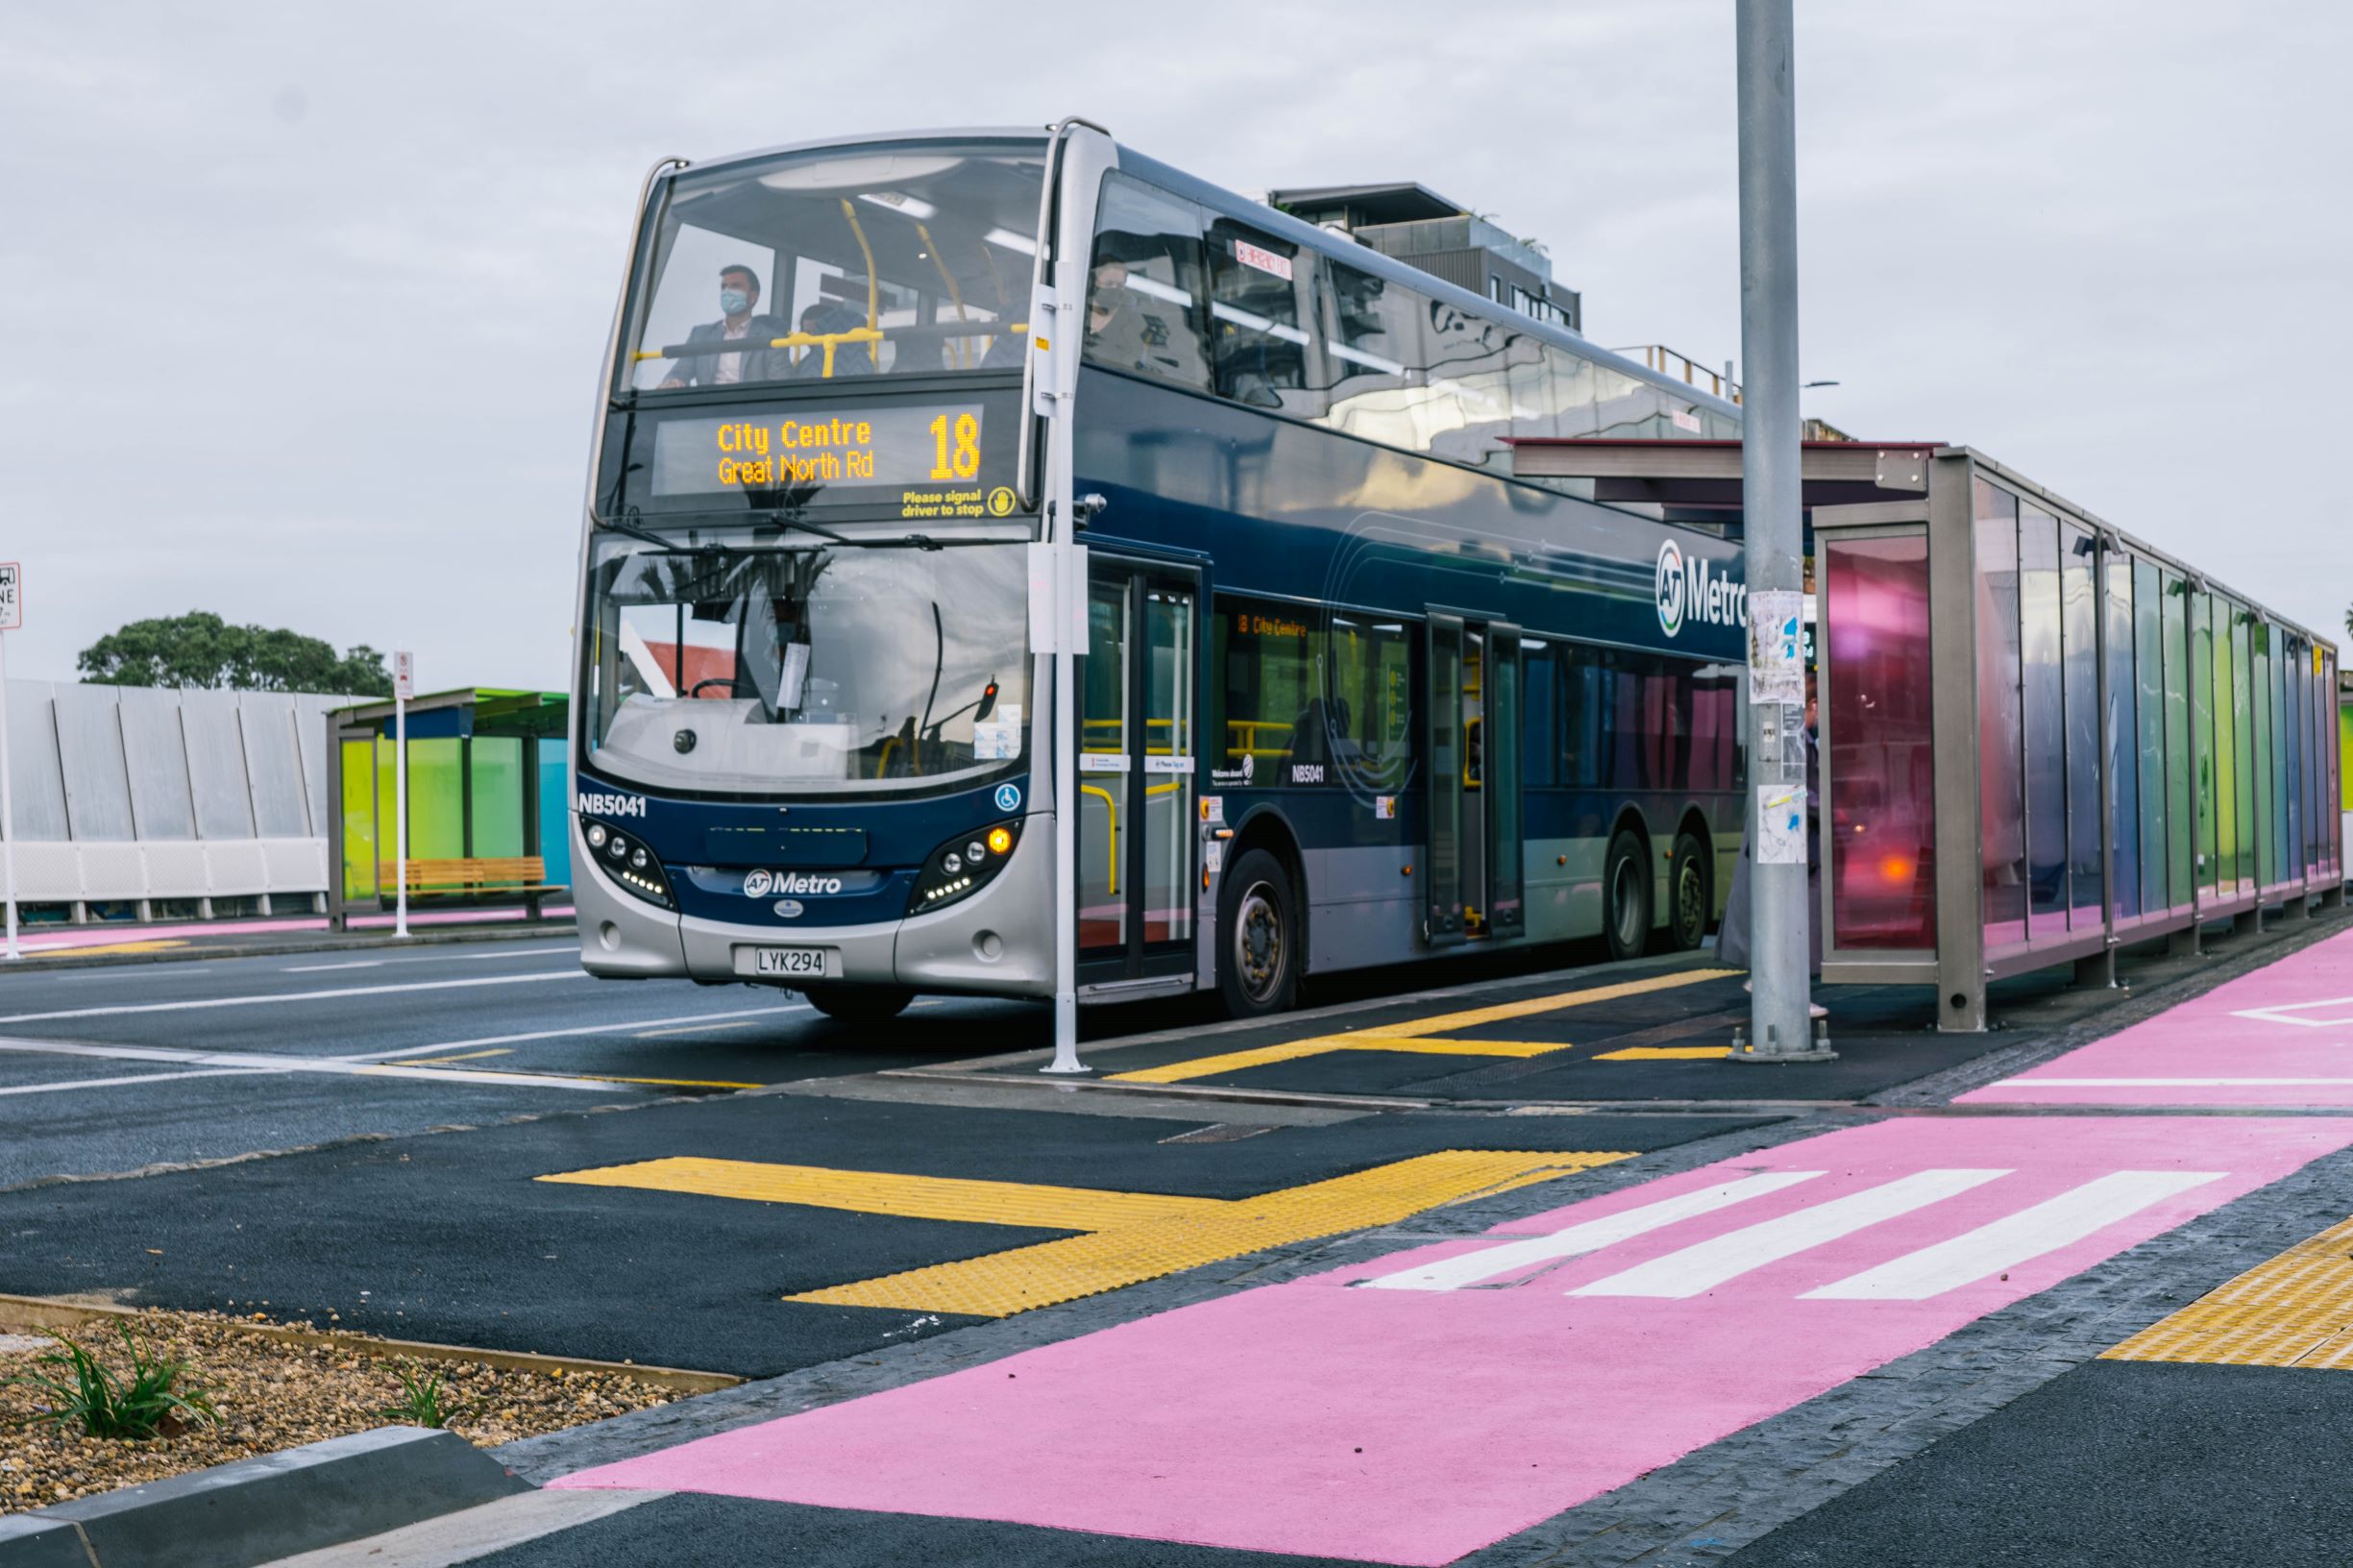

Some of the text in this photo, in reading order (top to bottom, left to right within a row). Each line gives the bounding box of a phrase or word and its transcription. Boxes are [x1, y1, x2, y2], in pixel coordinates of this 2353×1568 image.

[718, 417, 871, 455] City Centre
[929, 412, 981, 479] 18
[719, 450, 874, 485] Great North Rd
[902, 488, 982, 505] Please signal
[901, 504, 985, 518] driver to stop
[1253, 615, 1273, 635] City
[1274, 617, 1307, 638] Centre
[1291, 765, 1324, 783] NB5041
[578, 793, 647, 818] NB5041
[772, 872, 842, 894] Metro
[758, 951, 823, 972] LYK294
